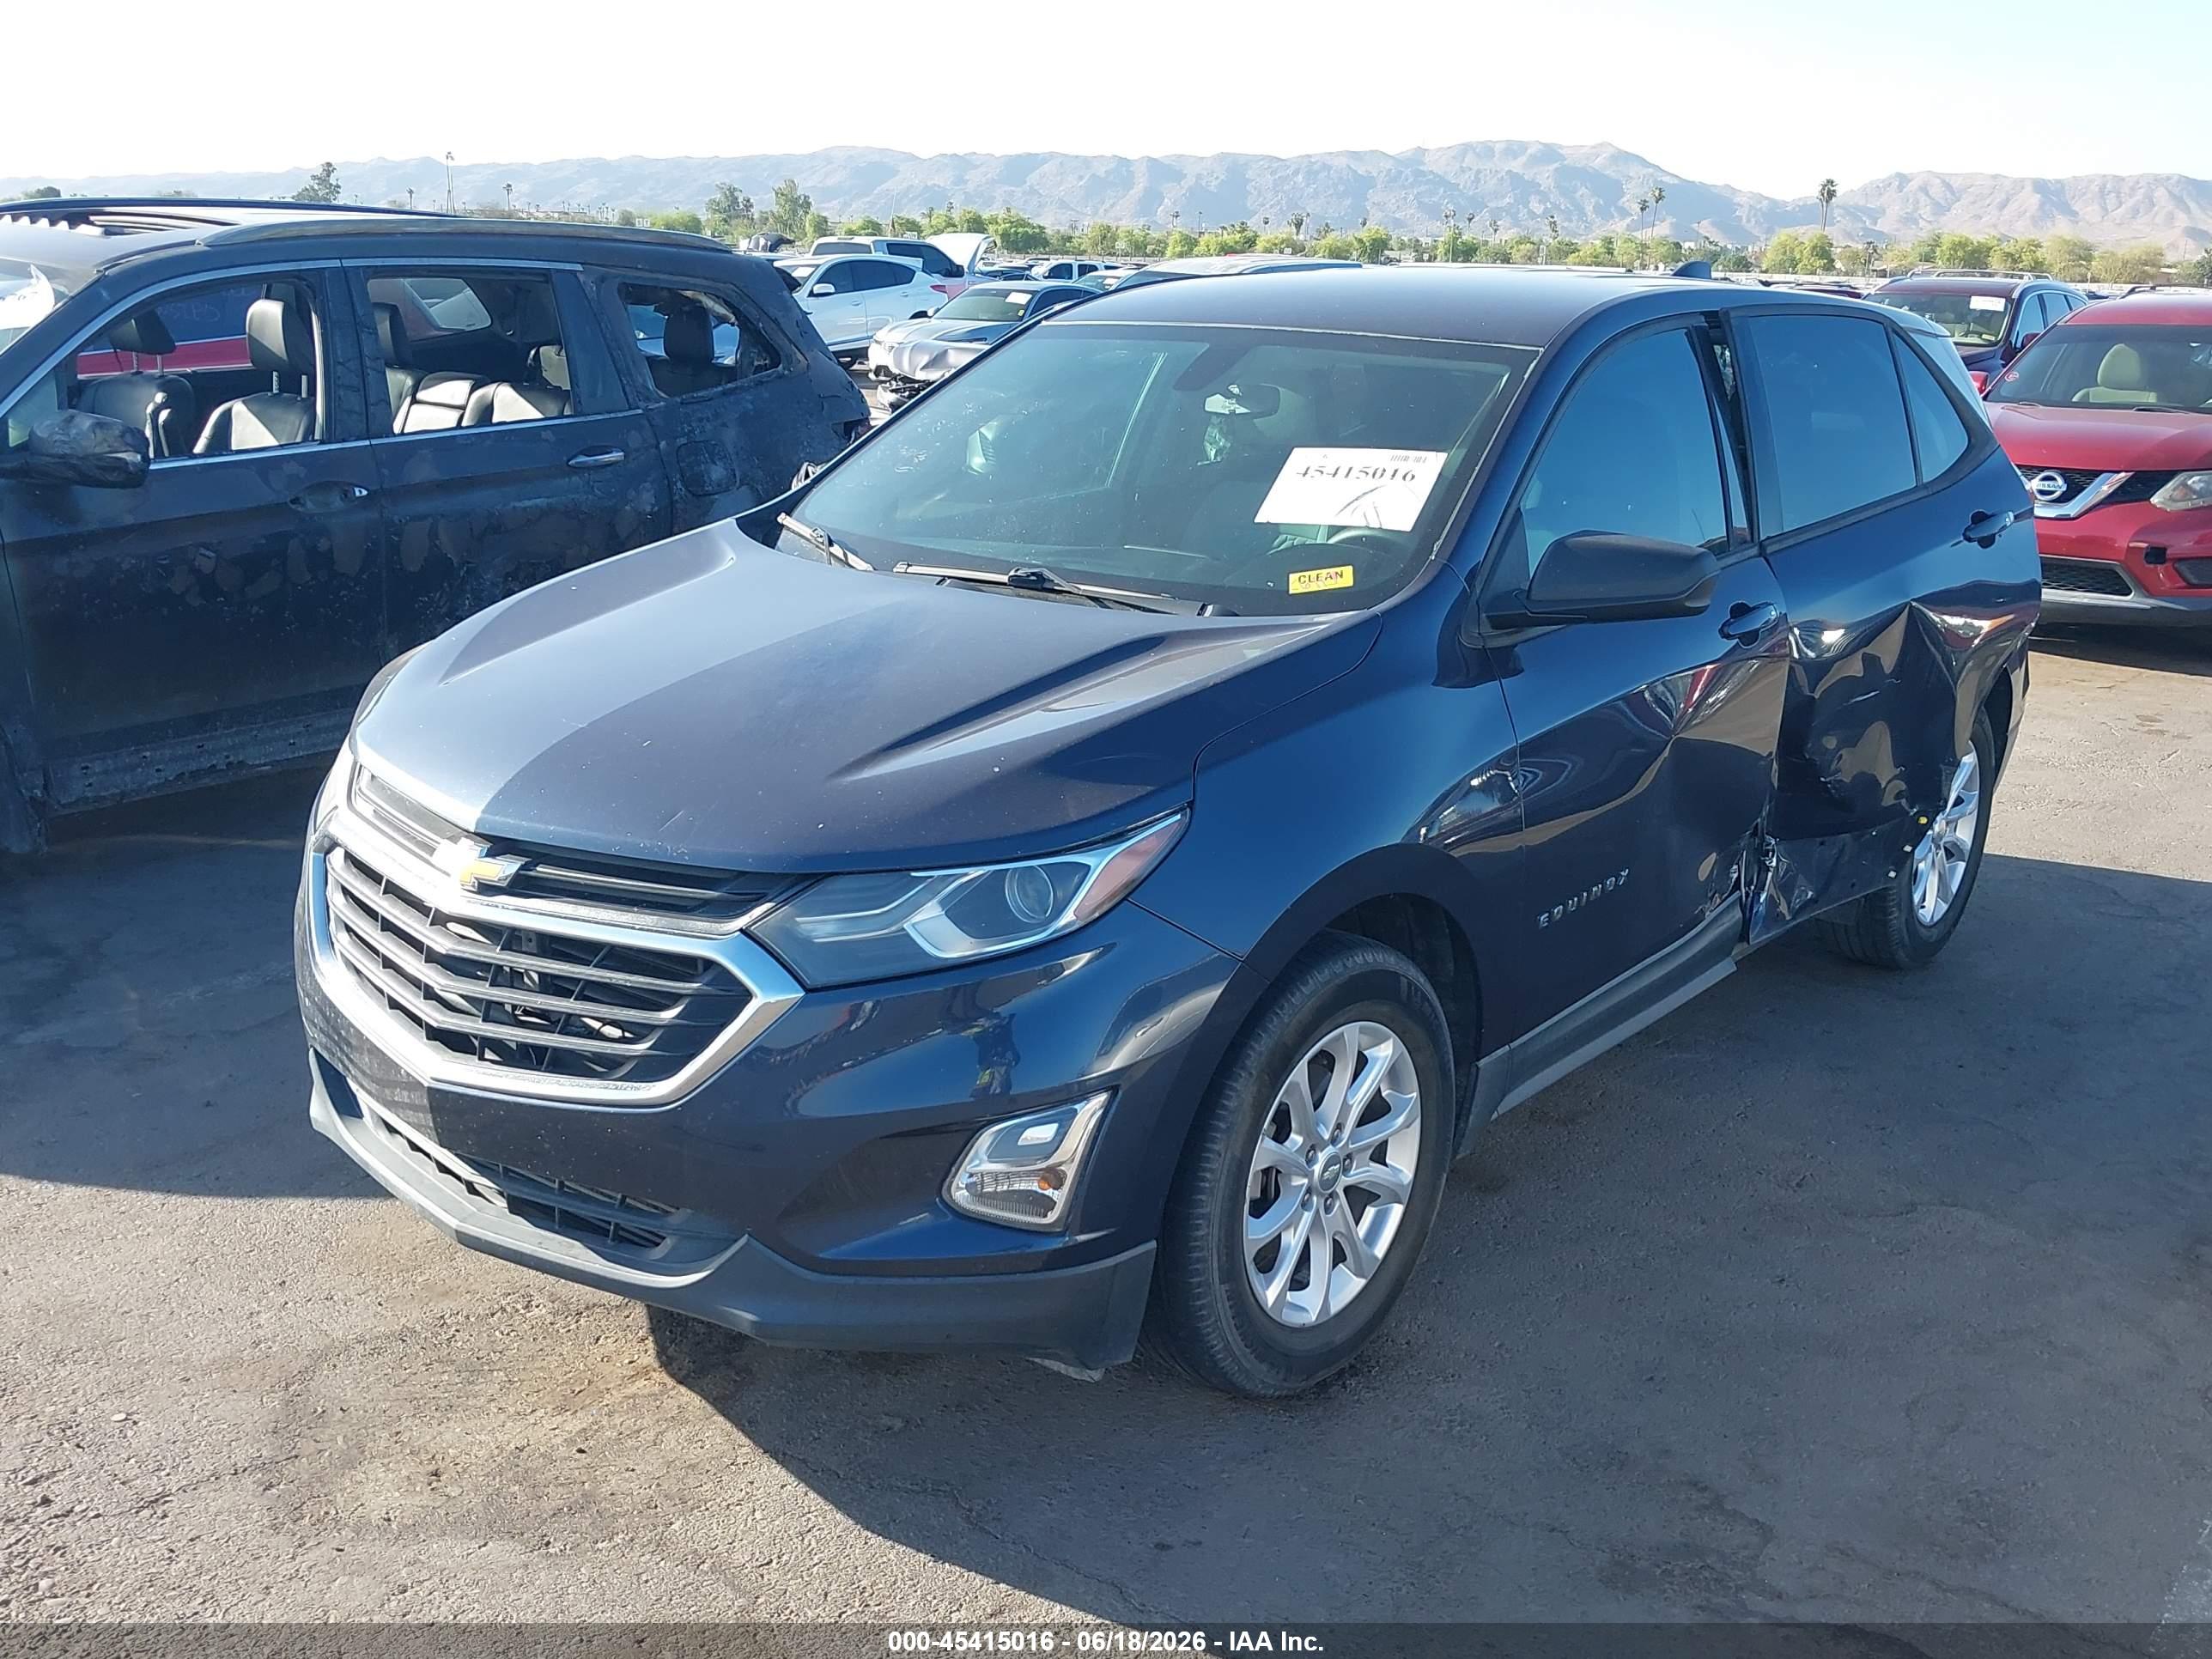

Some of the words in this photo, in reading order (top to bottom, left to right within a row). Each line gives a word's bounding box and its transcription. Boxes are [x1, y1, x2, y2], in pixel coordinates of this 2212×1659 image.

[1296, 465, 1416, 482] 45415016
[1297, 569, 1344, 585] CLEAN
[1538, 868, 1629, 928] EQUINOX
